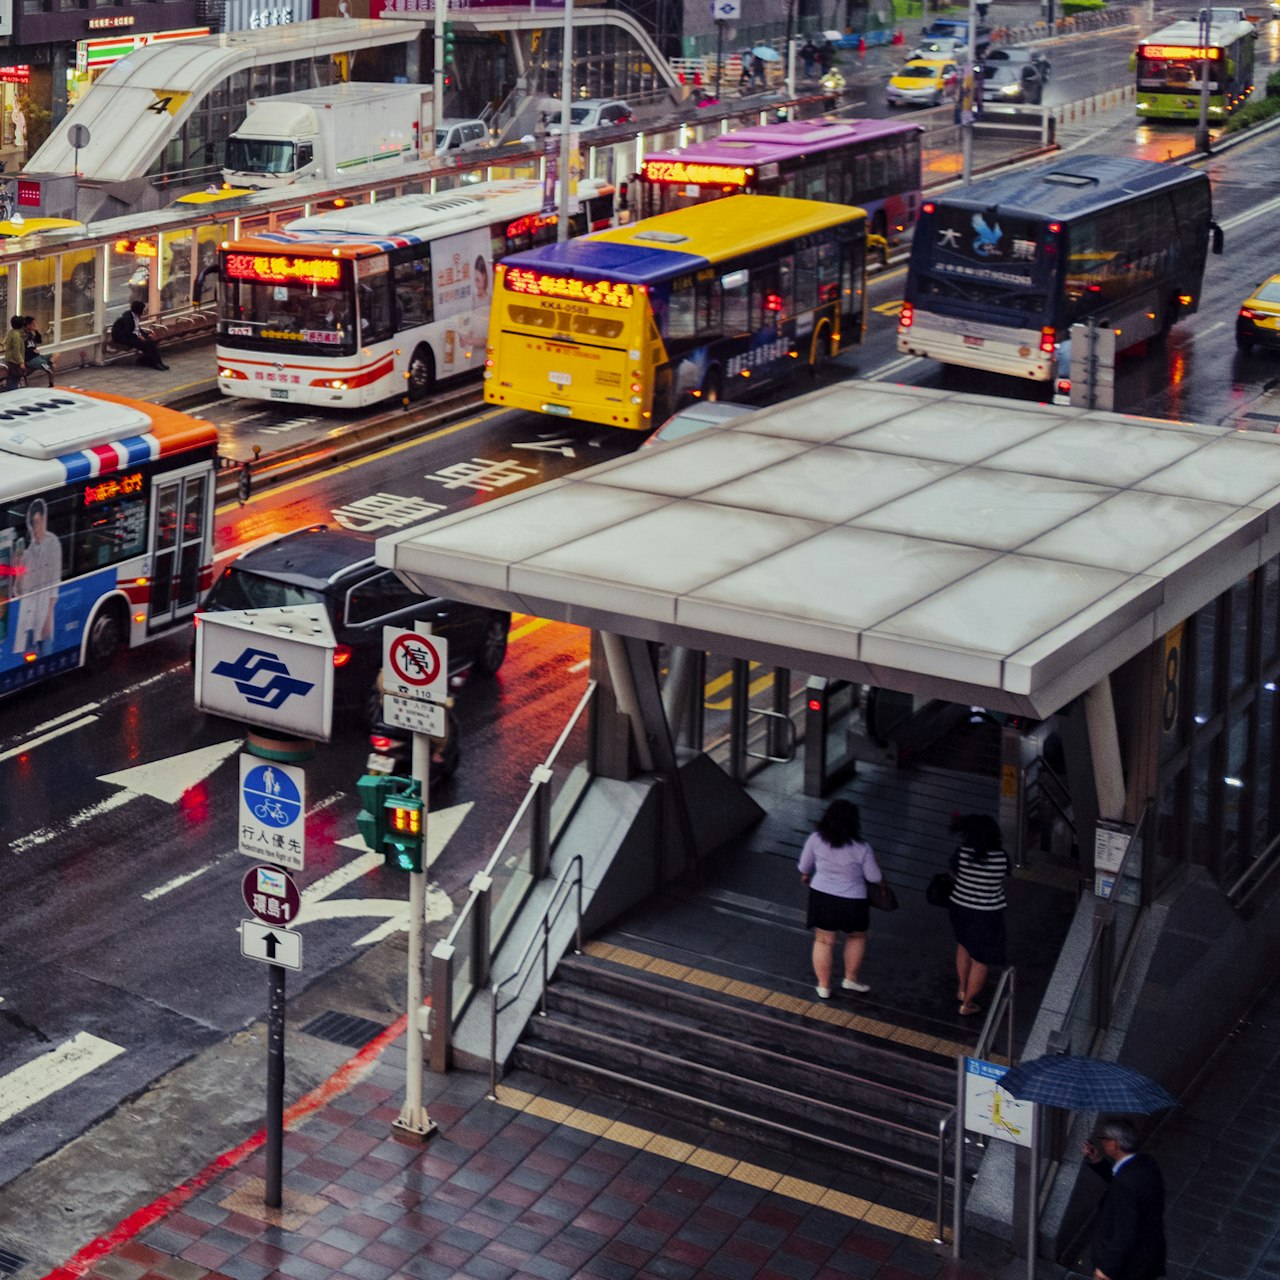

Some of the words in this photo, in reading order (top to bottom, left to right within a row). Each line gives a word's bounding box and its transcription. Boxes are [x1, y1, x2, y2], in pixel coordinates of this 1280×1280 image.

[146, 96, 173, 116] 4
[937, 228, 963, 249] 大
[401, 644, 429, 675] 停
[415, 688, 432, 699] 110
[241, 824, 301, 854] 行人優先
[252, 892, 291, 921] 環島1
